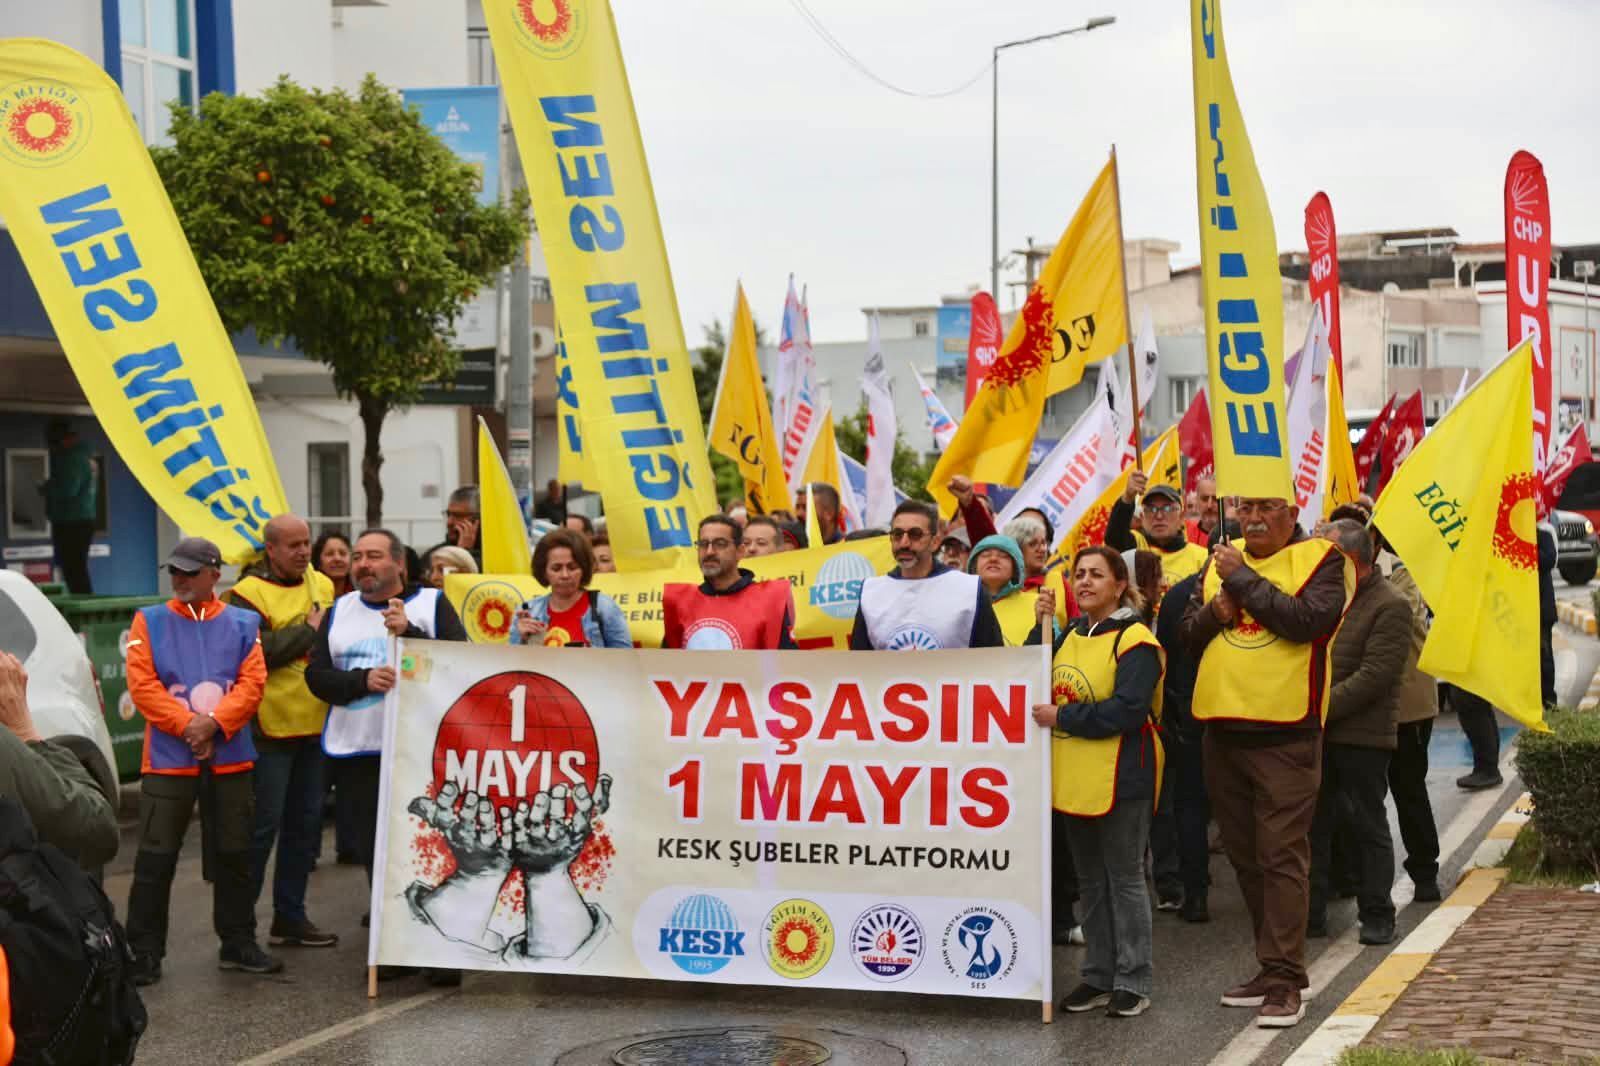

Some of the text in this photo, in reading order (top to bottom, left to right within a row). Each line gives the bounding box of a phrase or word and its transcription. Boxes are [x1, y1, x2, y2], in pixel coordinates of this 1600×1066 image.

[1513, 215, 1543, 244] CHP
[637, 587, 664, 604] BİL
[809, 579, 863, 606] KES
[508, 684, 527, 742] 1
[654, 679, 1027, 756] YAŞASIN
[445, 749, 587, 798] MAYIS
[668, 759, 1011, 829] 1 MAYIS
[657, 838, 1010, 871] KESK ŞUBELER PLATFORMU
[658, 927, 745, 956] KESK
[861, 955, 879, 963] TÜM
[970, 981, 987, 990] SES
